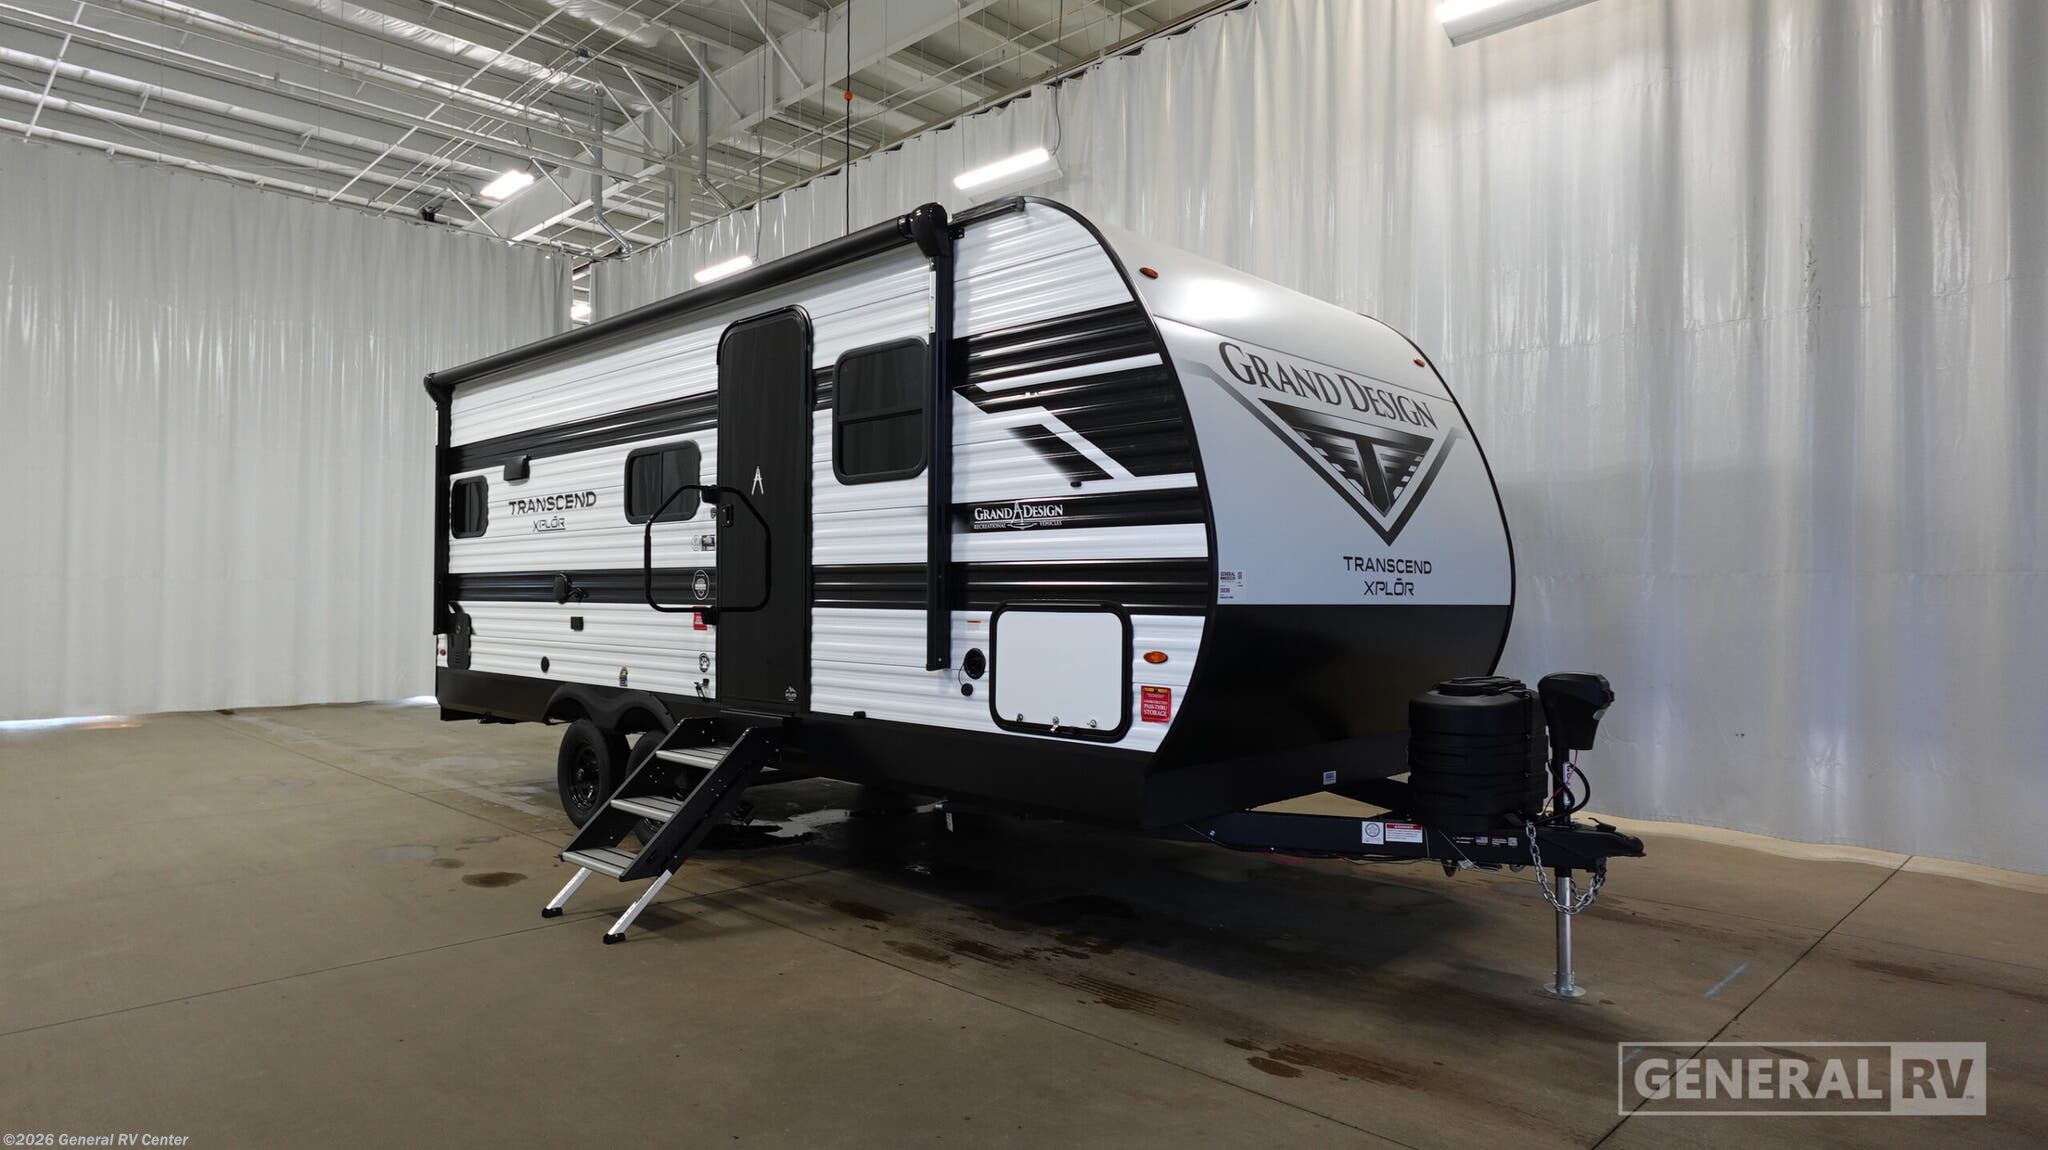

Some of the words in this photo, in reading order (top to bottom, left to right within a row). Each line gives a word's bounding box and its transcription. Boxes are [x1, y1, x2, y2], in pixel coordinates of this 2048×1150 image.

[1219, 342, 1342, 406] GRAND
[1335, 373, 1438, 430] DESIGN
[508, 491, 597, 515] TRANSCEND
[974, 507, 1013, 520] GRAND
[1022, 504, 1064, 518] DESIGN
[1343, 556, 1432, 574] TRANSCEND
